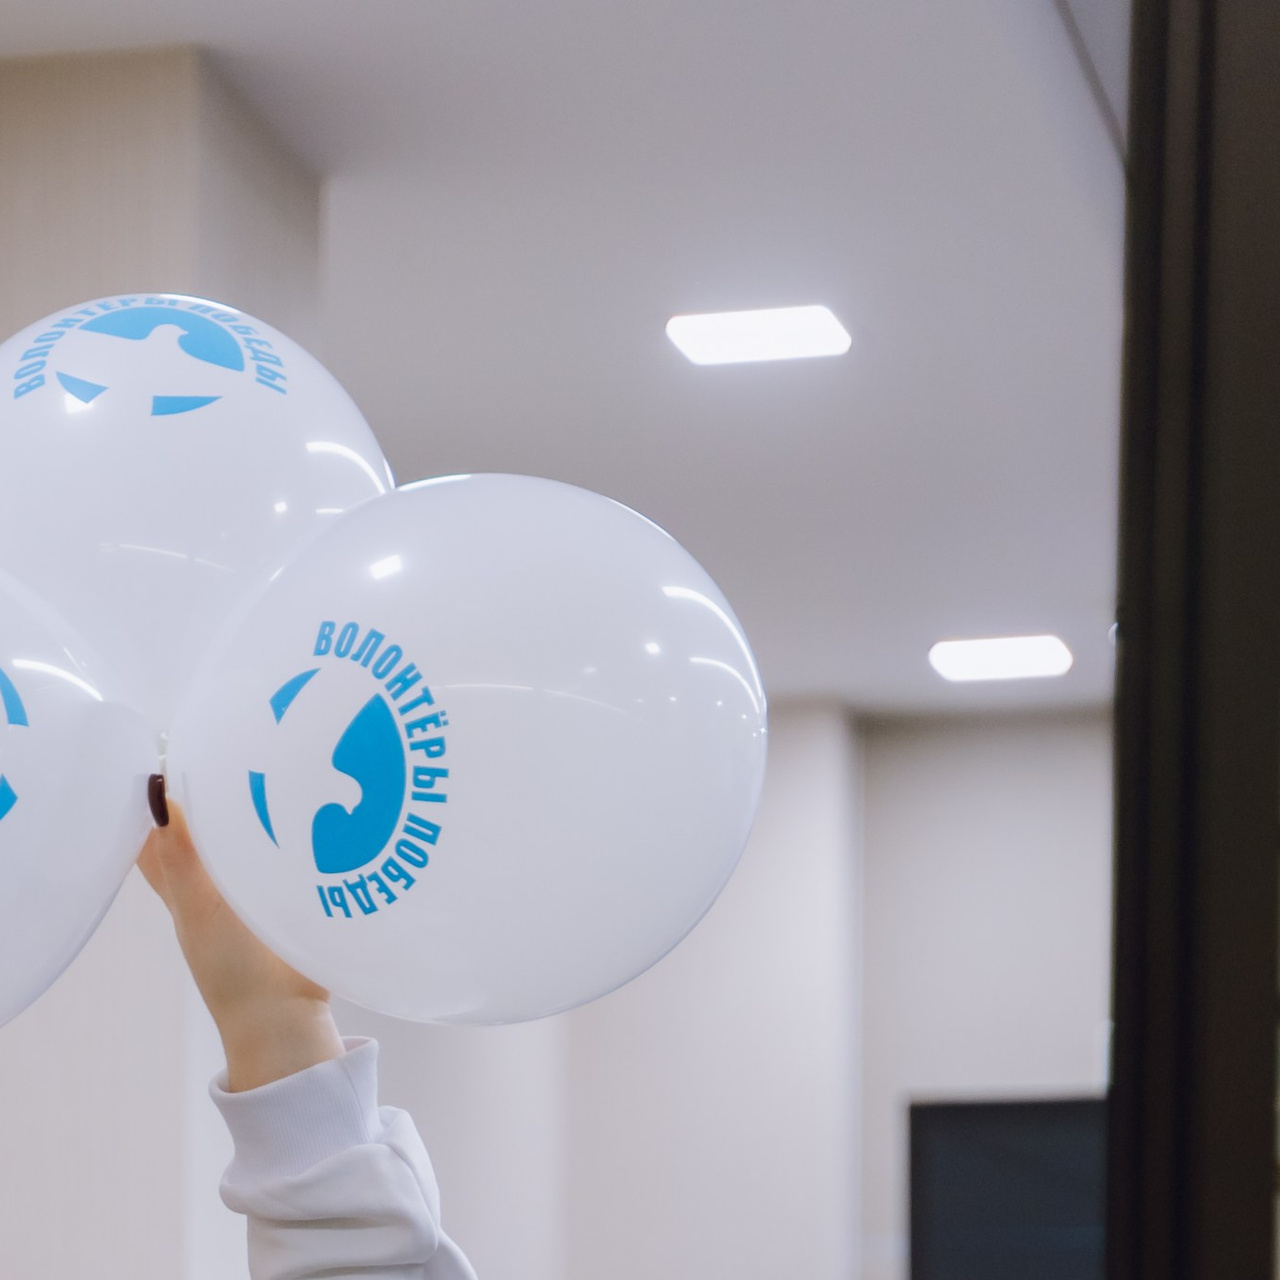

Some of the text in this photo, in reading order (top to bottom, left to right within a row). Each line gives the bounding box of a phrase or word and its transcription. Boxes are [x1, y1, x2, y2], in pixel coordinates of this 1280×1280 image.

[188, 303, 287, 395] ПОБЕДЫ
[313, 621, 449, 918] ВОЛОНТЁРЫ ПОБЕДЫ
